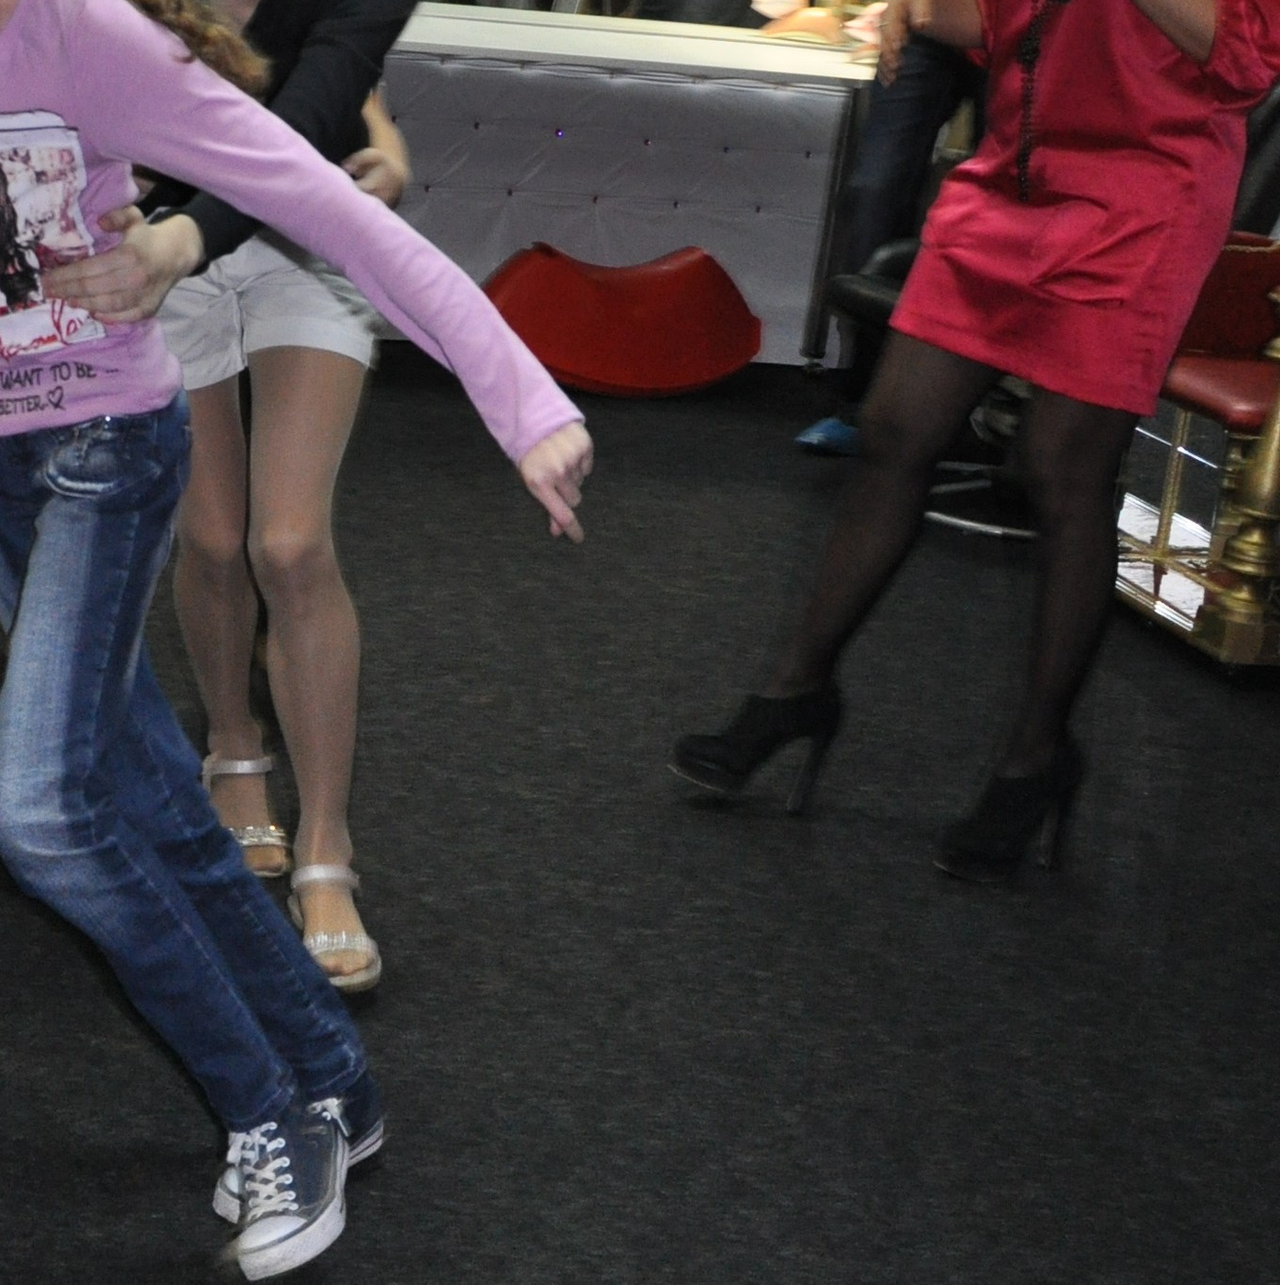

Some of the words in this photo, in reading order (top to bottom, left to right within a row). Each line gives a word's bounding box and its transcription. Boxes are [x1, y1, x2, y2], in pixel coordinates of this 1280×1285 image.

[0, 368, 43, 391] WANT
[50, 362, 71, 383] TO
[75, 360, 97, 379] BE
